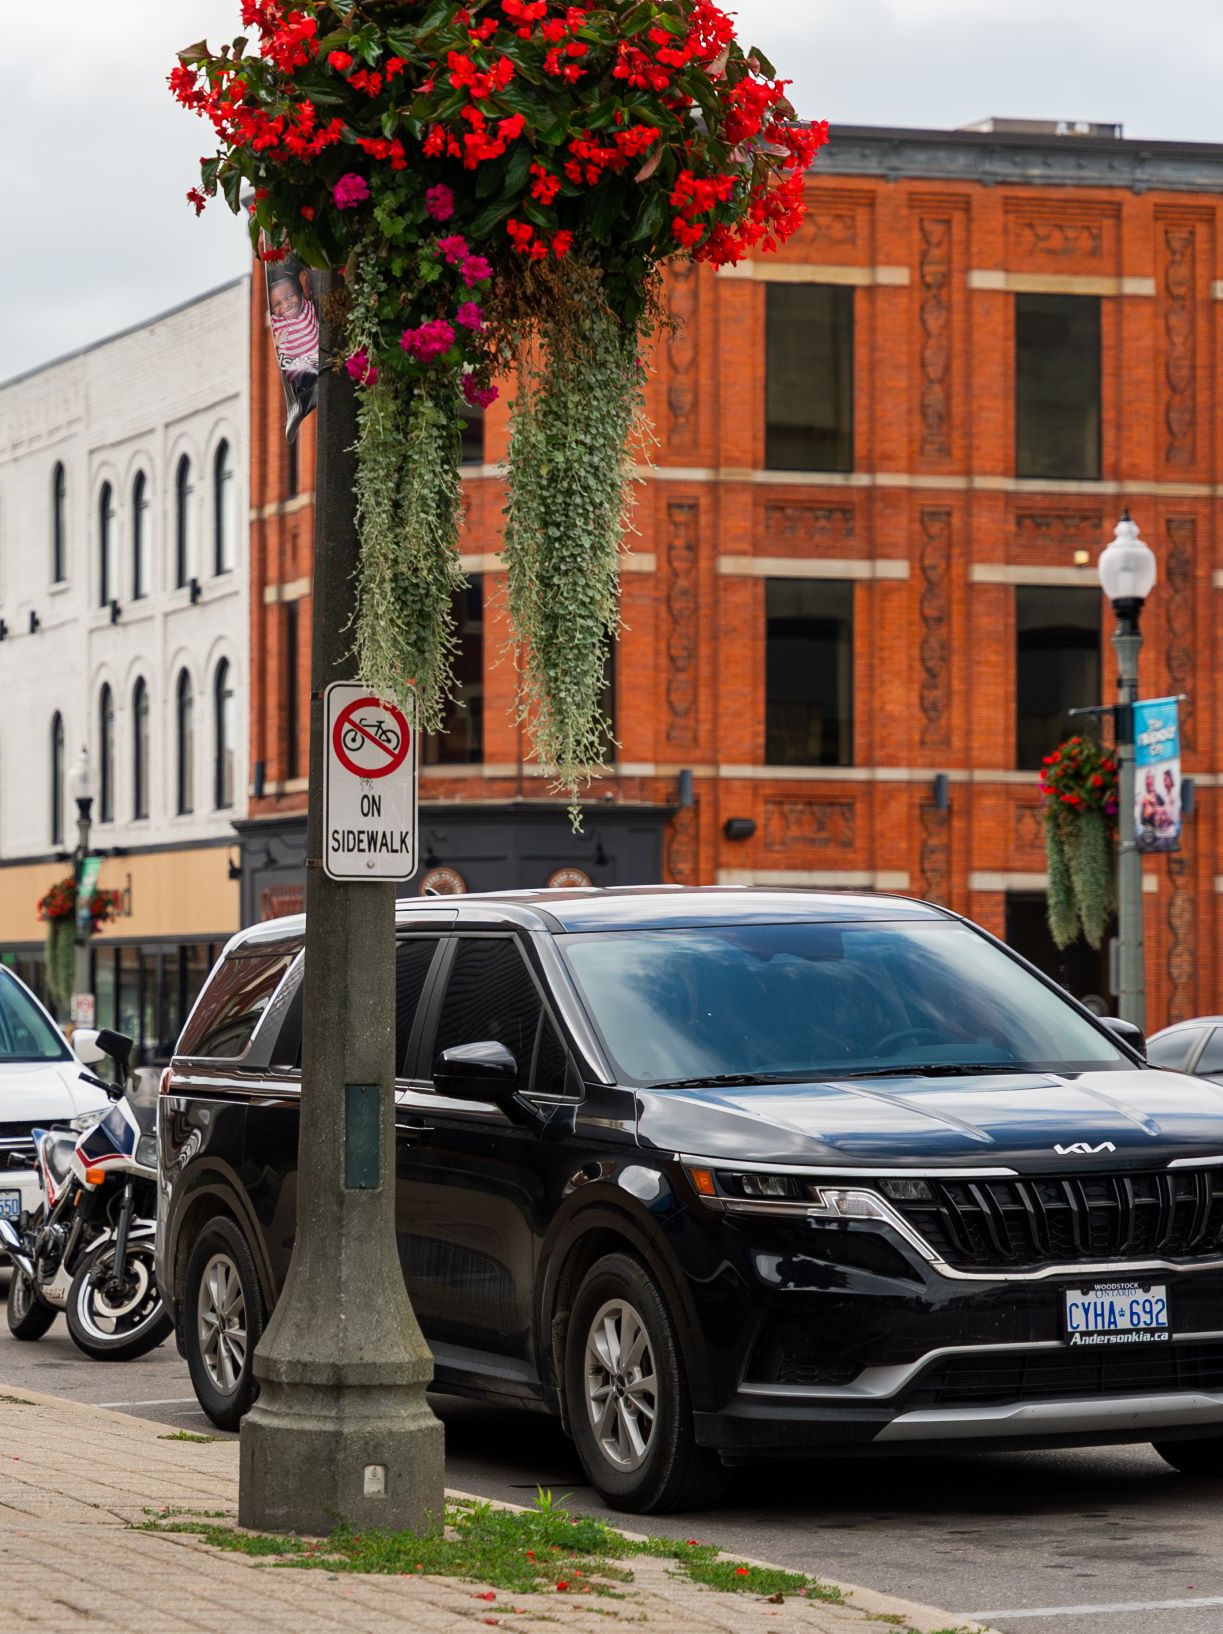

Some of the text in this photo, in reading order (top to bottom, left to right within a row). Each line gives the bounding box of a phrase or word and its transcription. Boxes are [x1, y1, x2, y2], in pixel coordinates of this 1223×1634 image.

[360, 794, 382, 818] ON
[331, 829, 410, 854] SIDEWALK
[1094, 1282, 1139, 1291] WOODSTOCK
[1094, 1289, 1137, 1299] ONTARIO
[1068, 1298, 1167, 1331] CYHA 692
[1070, 1331, 1169, 1346] Andersonkia.ca
